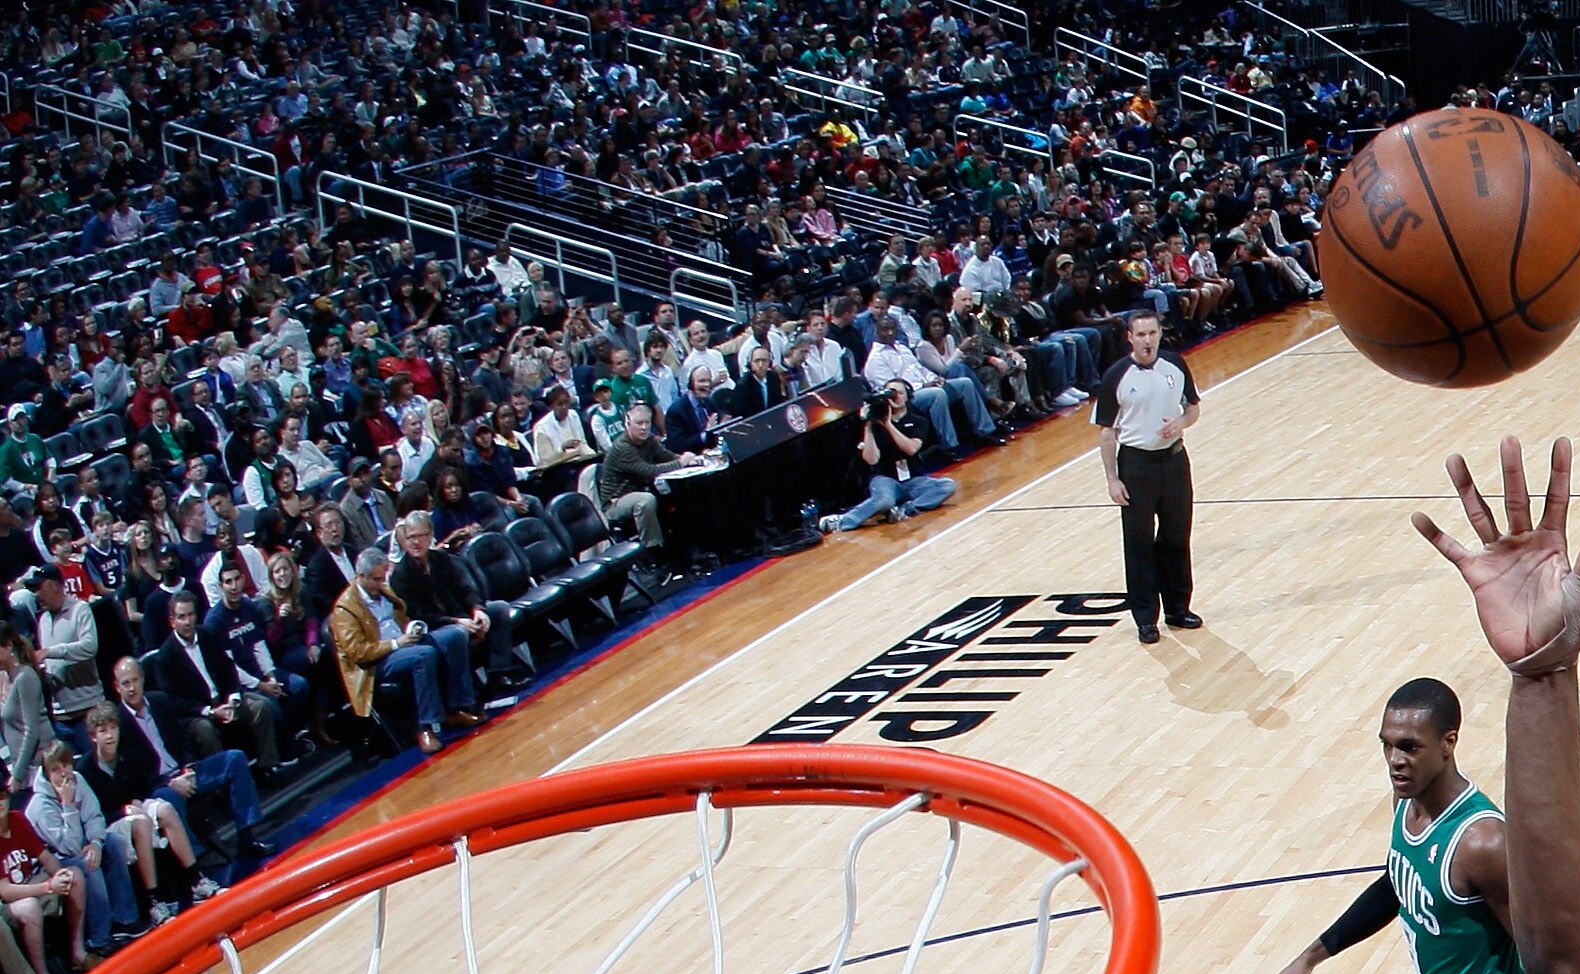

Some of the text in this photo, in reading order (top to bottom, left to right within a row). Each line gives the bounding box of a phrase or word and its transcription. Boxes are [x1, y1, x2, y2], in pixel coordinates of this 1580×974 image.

[1352, 145, 1423, 250] SPALD
[768, 638, 960, 736] AREN
[868, 592, 1133, 742] PHILIP
